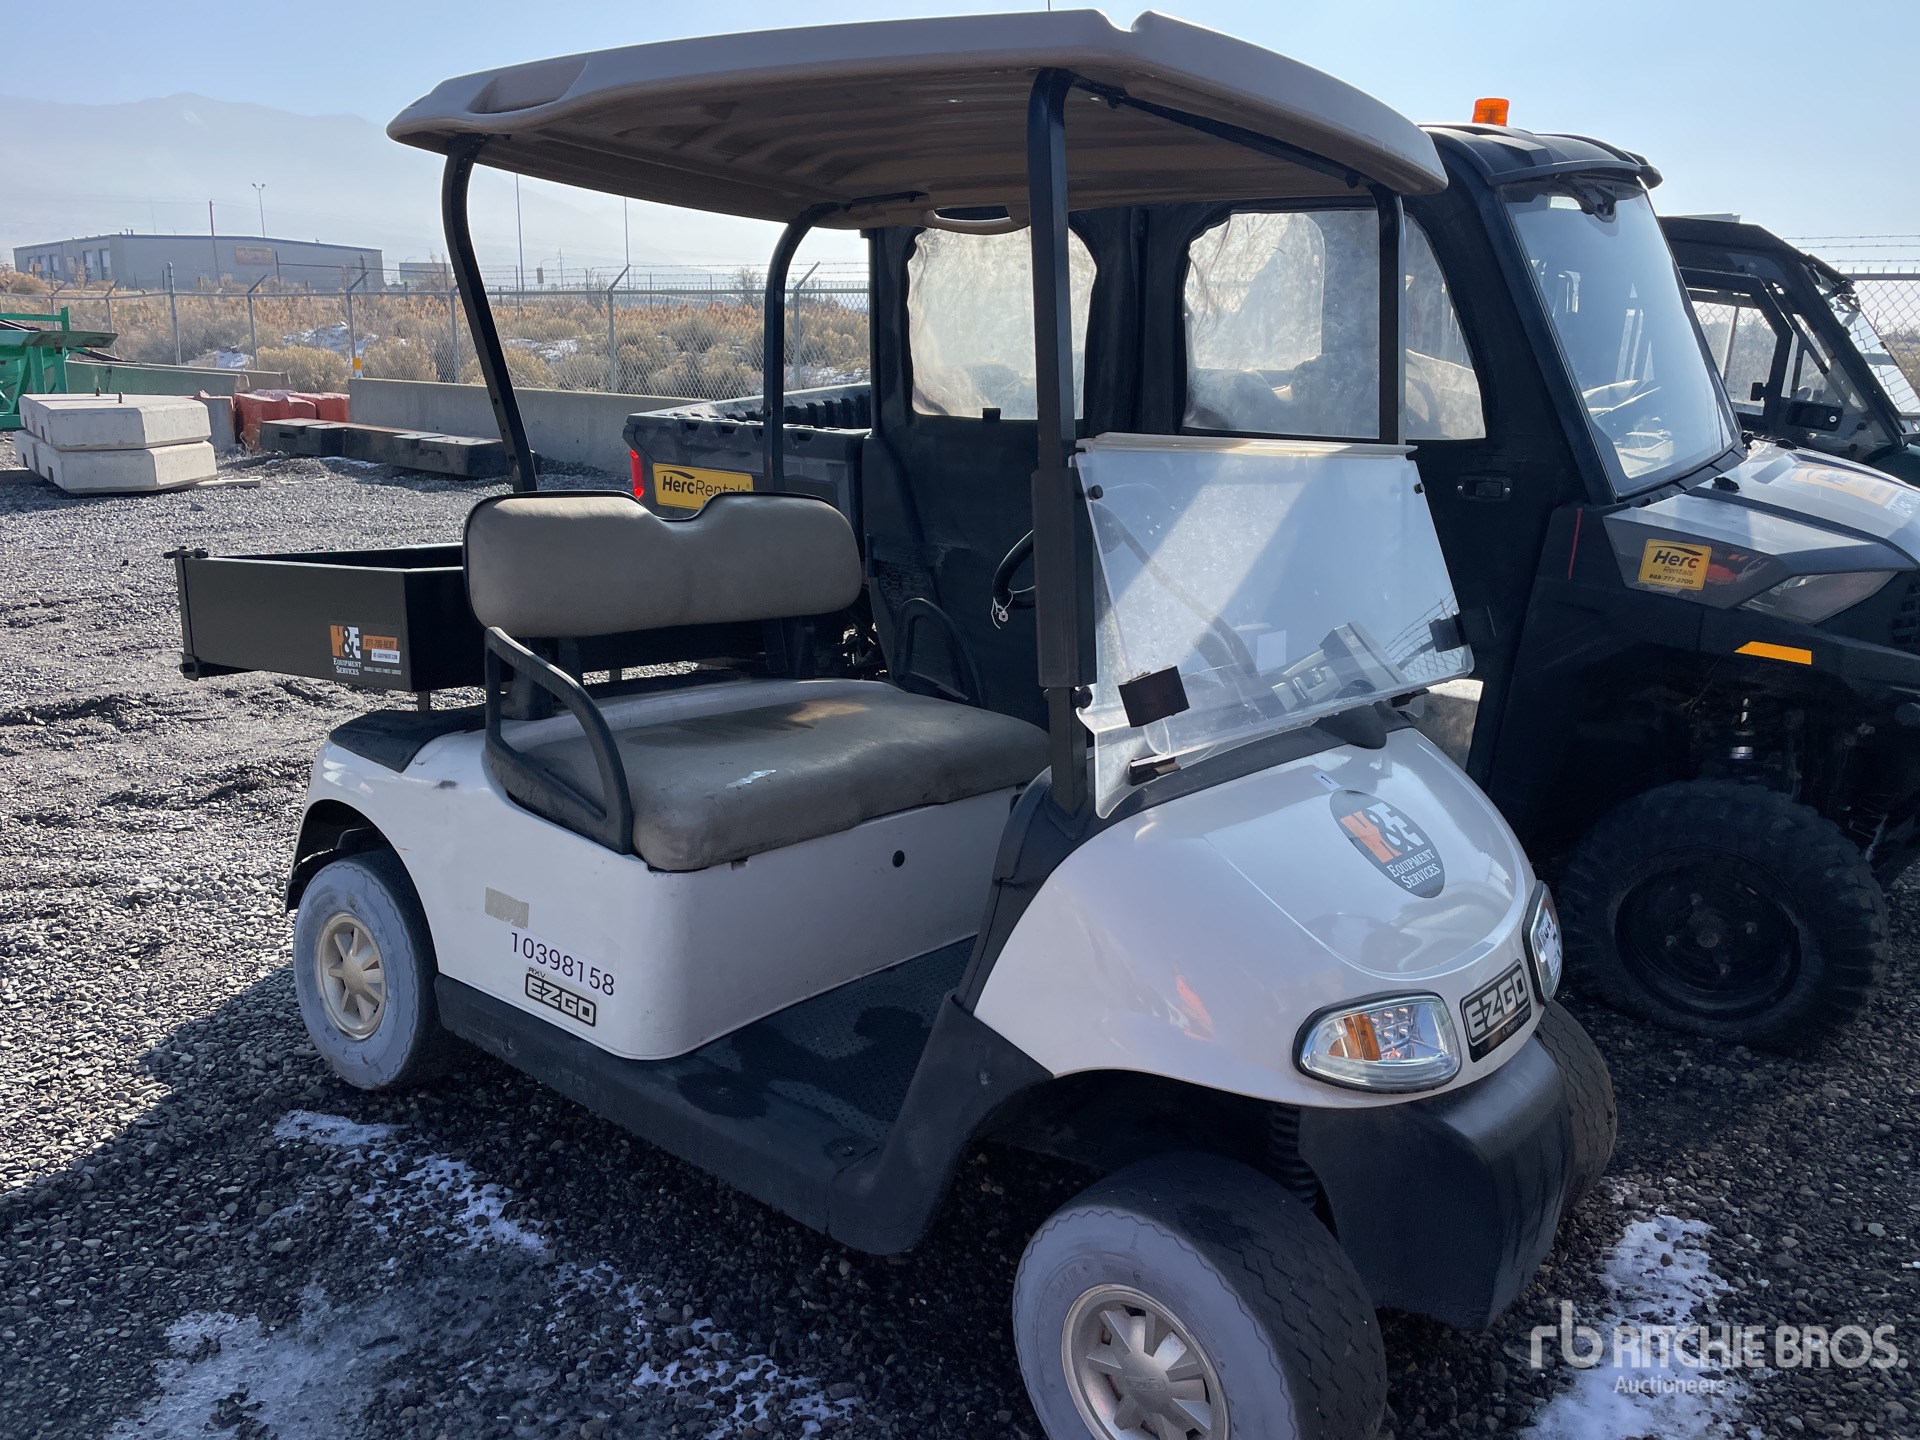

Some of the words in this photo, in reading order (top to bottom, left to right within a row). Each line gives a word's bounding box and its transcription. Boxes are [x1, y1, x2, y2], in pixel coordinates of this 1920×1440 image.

[1652, 549, 1700, 569] Herc
[1662, 565, 1694, 577] Rentals
[330, 625, 361, 659] H&E
[333, 657, 361, 668] EQUIPMENT
[336, 665, 360, 676] SERVICES
[1340, 802, 1425, 864] H&E
[1386, 848, 1435, 878] EQUIPMENT
[1401, 863, 1441, 889] SERVICES
[511, 931, 615, 996] 10398158
[528, 966, 546, 979] RXV
[526, 974, 595, 1026] EZGO
[1464, 968, 1529, 1039] EZGO
